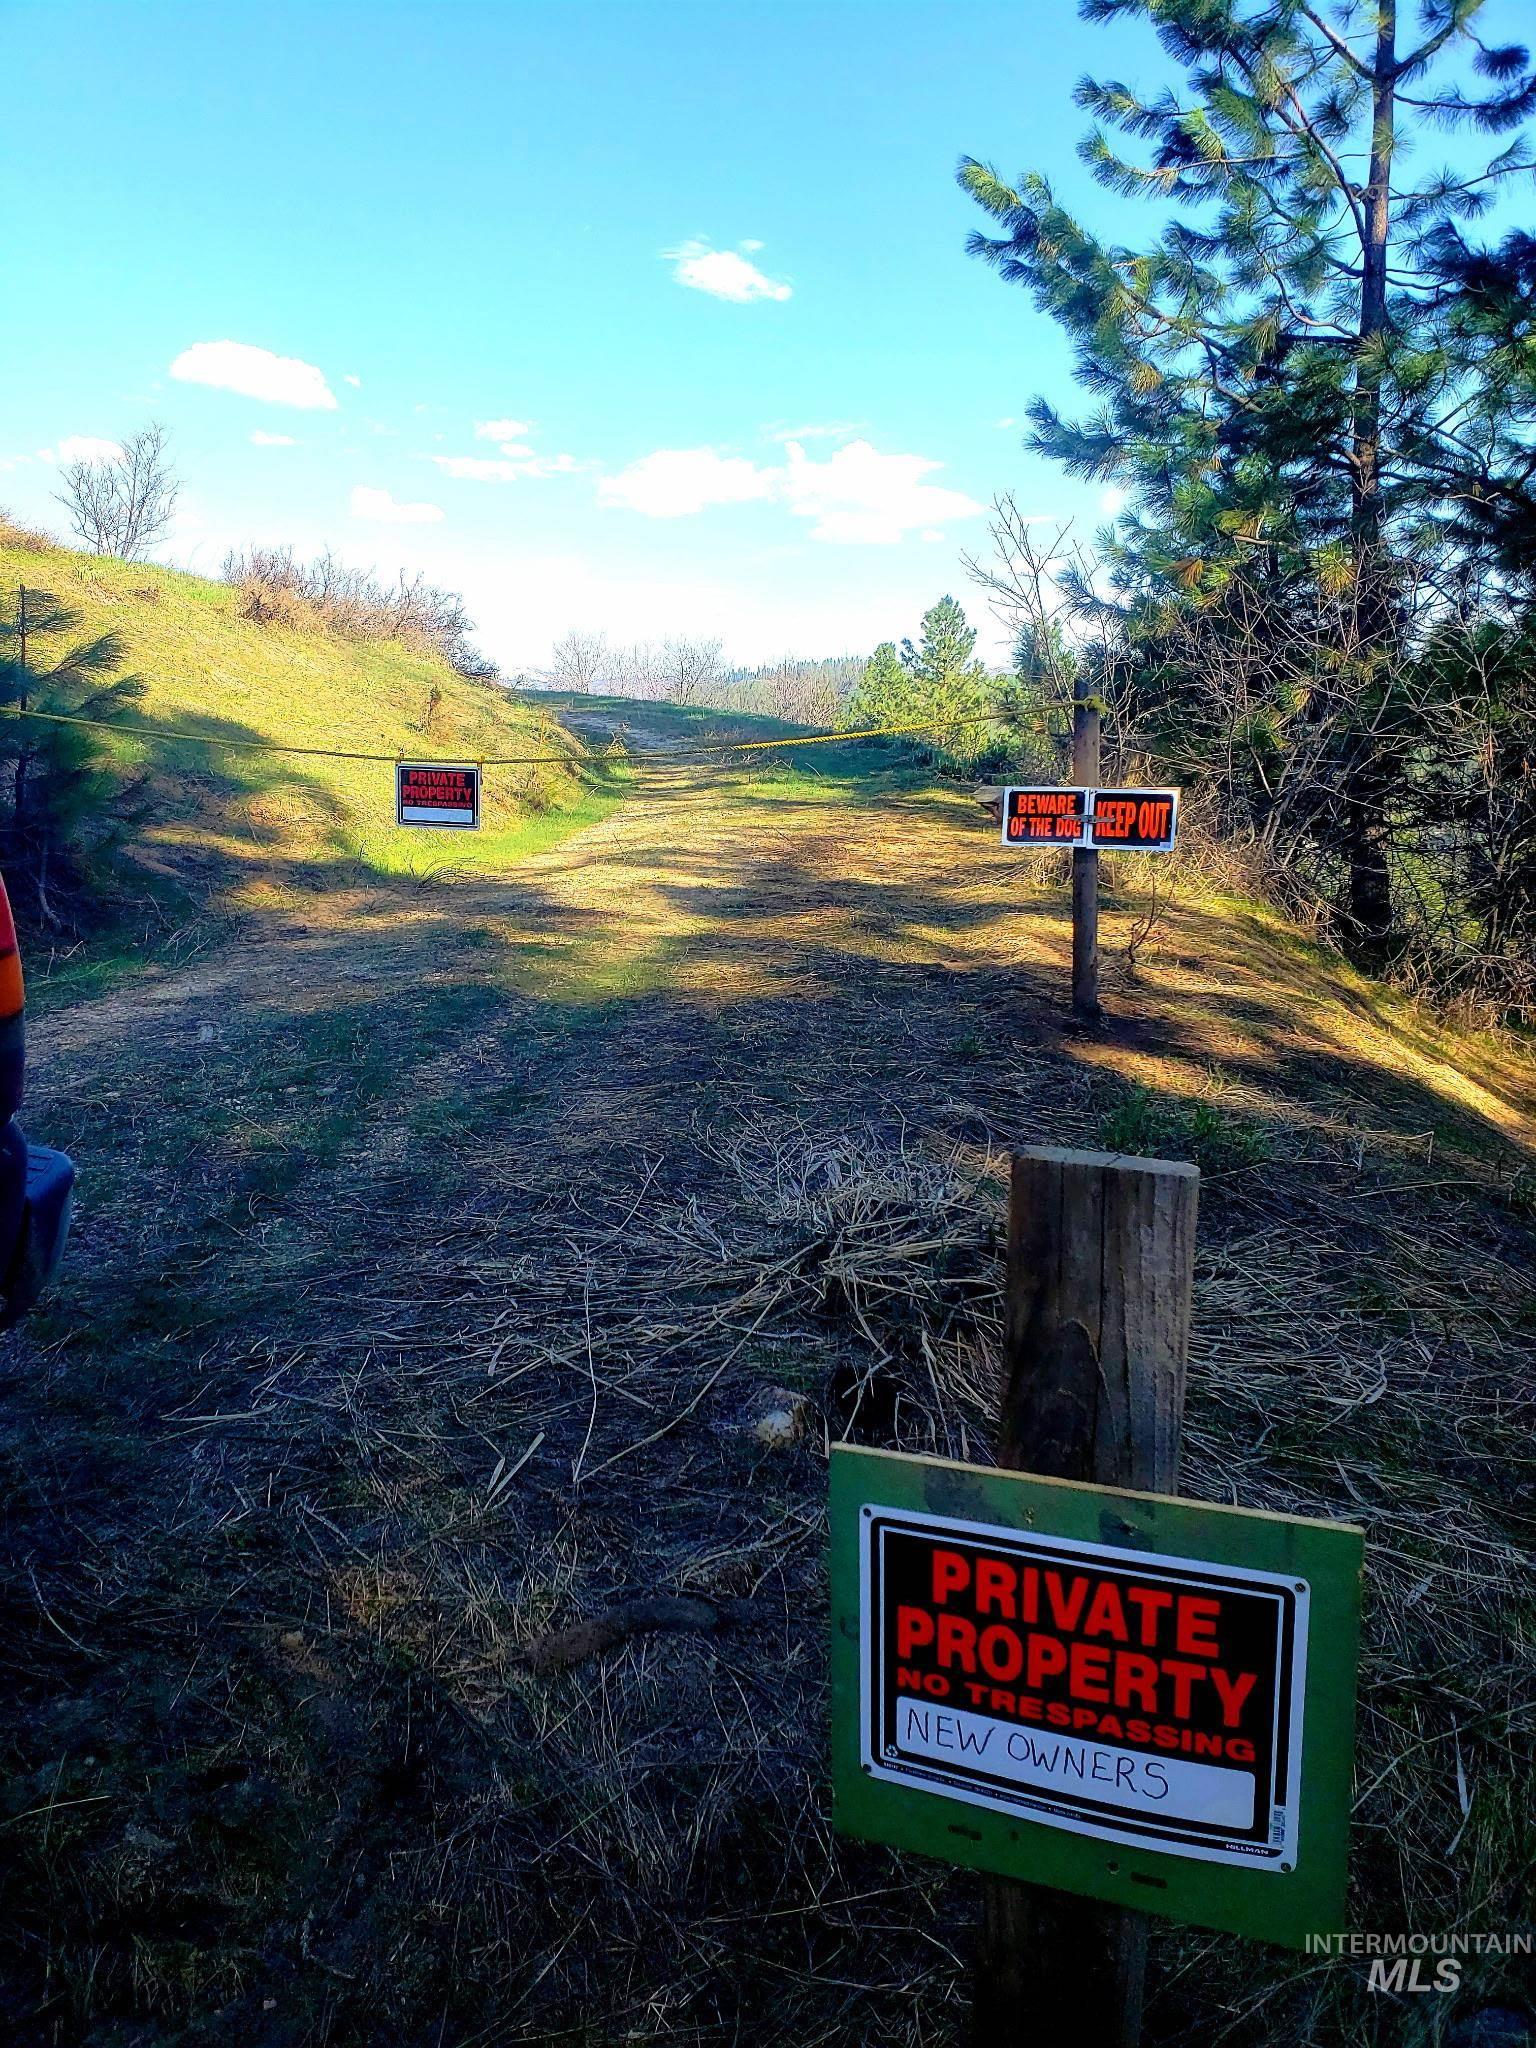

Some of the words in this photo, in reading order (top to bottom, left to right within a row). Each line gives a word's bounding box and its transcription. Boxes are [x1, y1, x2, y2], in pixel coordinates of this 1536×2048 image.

[402, 784, 472, 801] PROPERTY
[409, 771, 466, 787] PRIVATE
[1017, 794, 1077, 815] BEWARE
[1010, 817, 1027, 837] OF
[1029, 817, 1053, 837] THE
[1055, 817, 1081, 838] DOG
[1095, 801, 1137, 838] KEEP
[1138, 801, 1170, 839] OUT
[932, 1549, 1221, 1659] PRIVATE
[897, 1605, 1257, 1729] PROPERTY
[897, 1667, 950, 1697] NO
[964, 1682, 1256, 1762] TRESPASSING
[906, 1707, 996, 1756] NEW
[1007, 1732, 1169, 1800] OWNERS
[1225, 1842, 1269, 1856] HILLMAN
